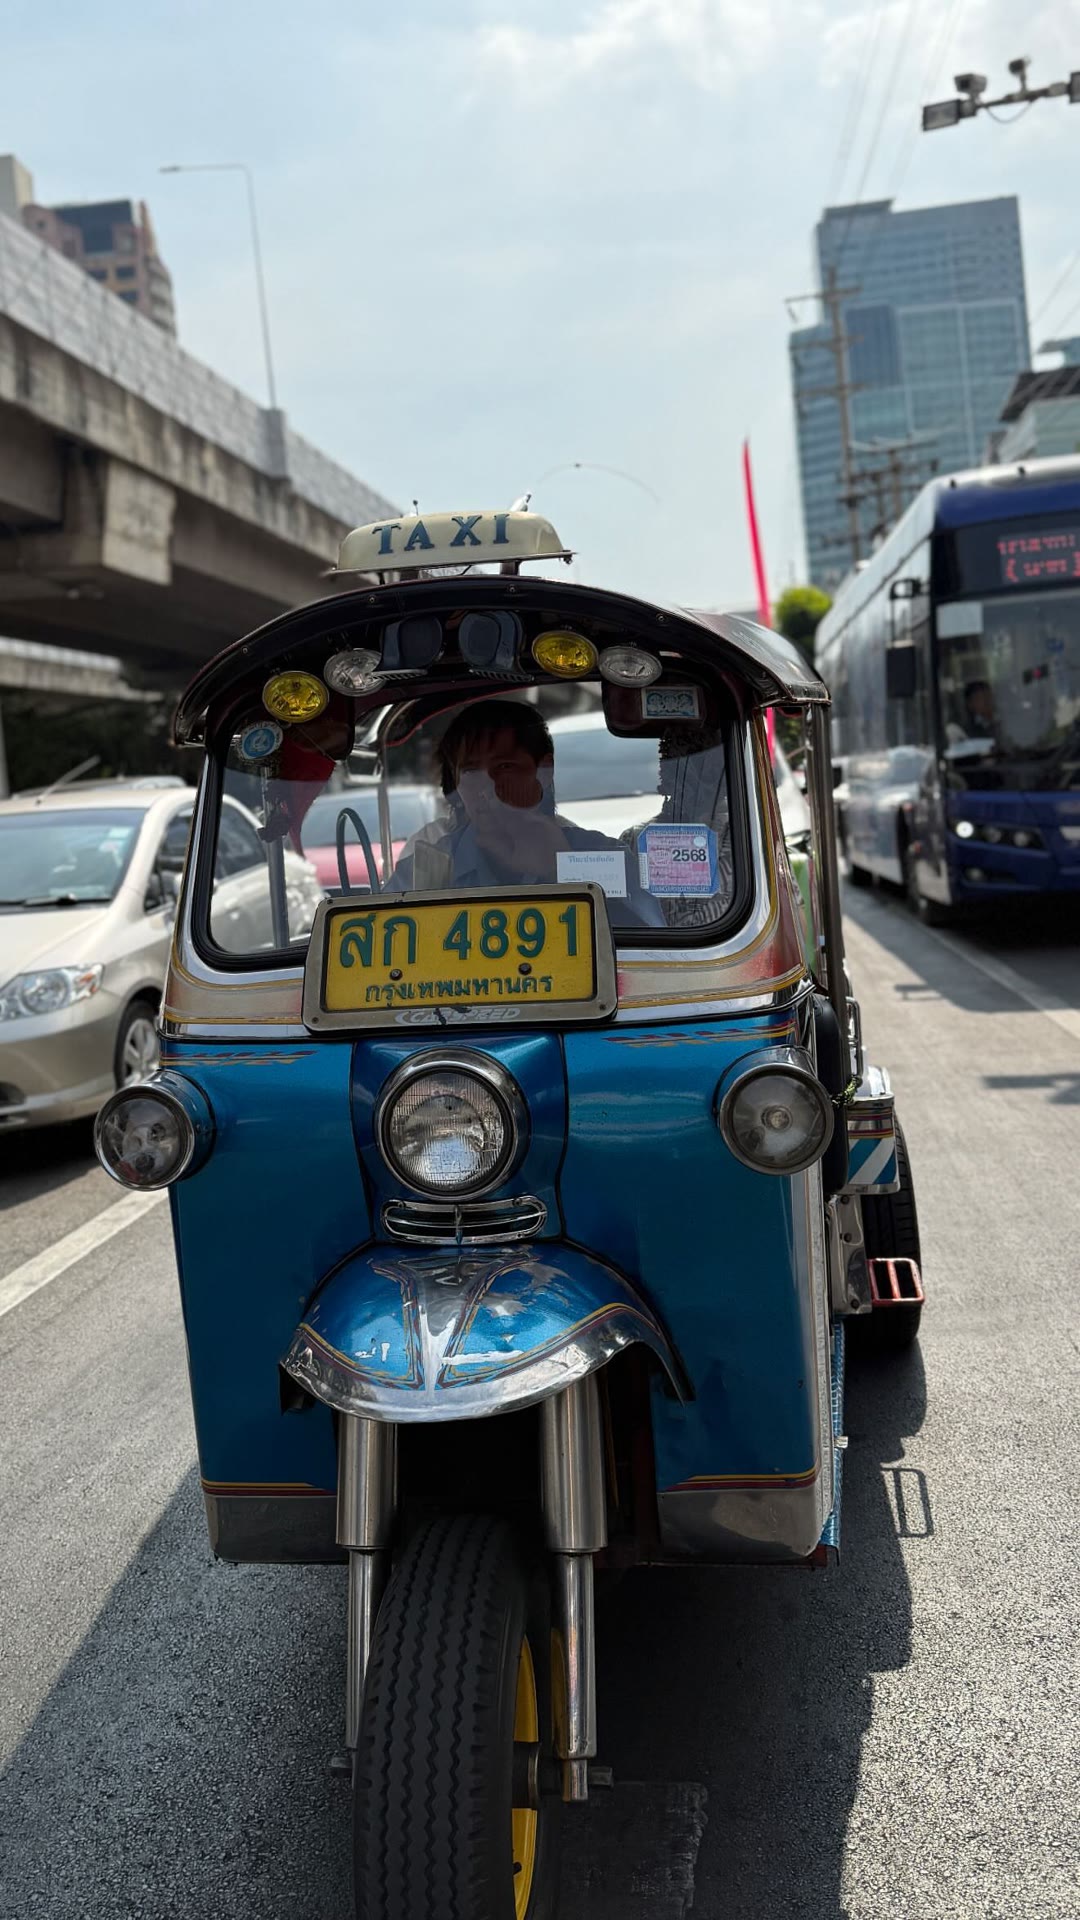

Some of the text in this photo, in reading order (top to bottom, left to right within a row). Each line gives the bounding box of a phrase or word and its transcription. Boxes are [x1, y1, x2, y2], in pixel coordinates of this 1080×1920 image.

[372, 513, 511, 555] TAXI
[672, 848, 708, 862] 2568
[339, 904, 578, 968] สก 4891
[365, 975, 554, 1007] กรุงเทพมหานคร
